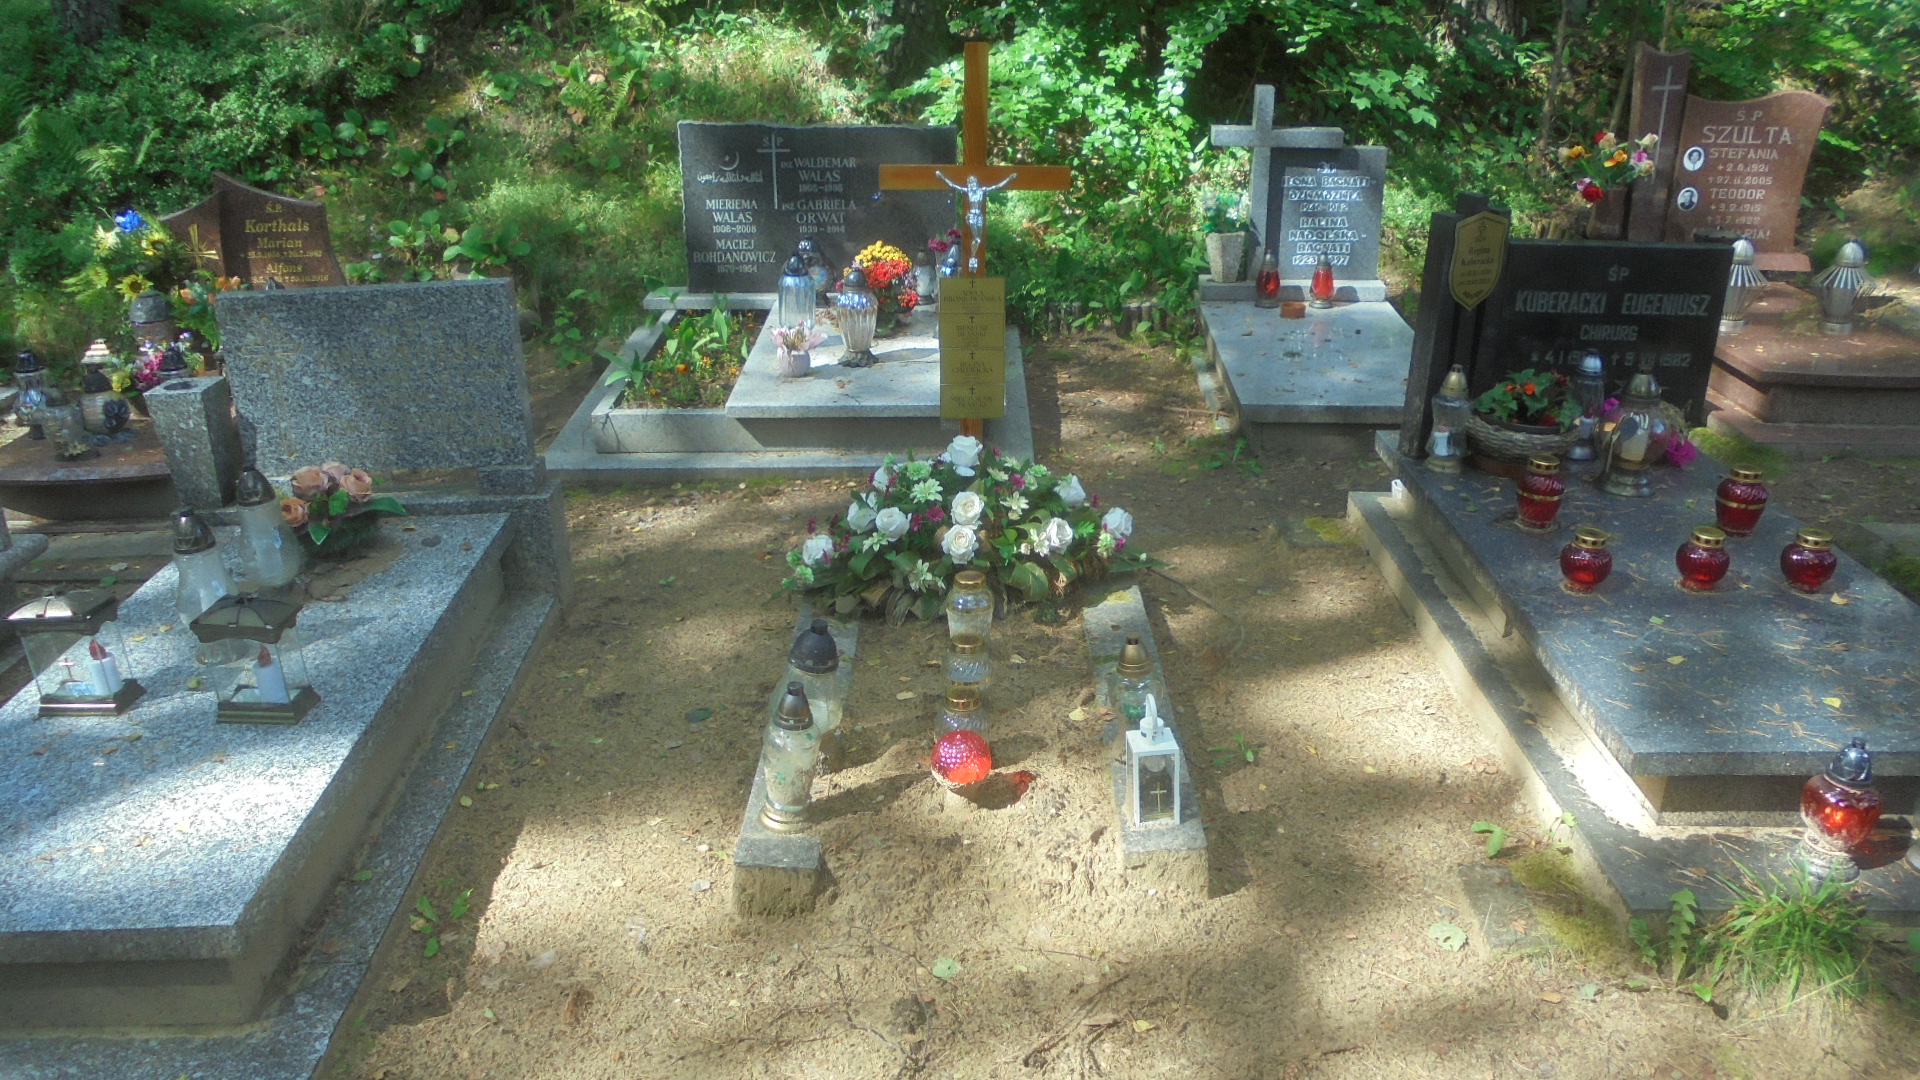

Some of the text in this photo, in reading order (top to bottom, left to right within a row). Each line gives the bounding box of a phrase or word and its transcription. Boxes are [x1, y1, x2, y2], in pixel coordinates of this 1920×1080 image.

[1701, 125, 1793, 146] SZULTA
[1709, 147, 1779, 161] STEFANIA
[794, 156, 857, 169] WALDEMAR
[798, 170, 841, 182] WALAS
[1710, 187, 1767, 200] TEODOR
[706, 198, 758, 210] MIERIEMA
[796, 199, 857, 210] GABRIELA
[712, 211, 754, 223] WALAS
[796, 211, 846, 225] ORWAT
[1299, 216, 1349, 228] HALINA
[244, 218, 310, 233] Korthals
[1288, 229, 1359, 242] NADOLSKA
[257, 237, 303, 249] Marian
[716, 239, 756, 251] MACIEJ
[1296, 242, 1351, 254] BAGNATI
[693, 251, 777, 264] BOHDANOWICZ
[265, 262, 303, 275] Alfons
[1515, 290, 1712, 317] KUBERACKI EUGENIUSZ
[1579, 325, 1639, 342] CHIRURG
